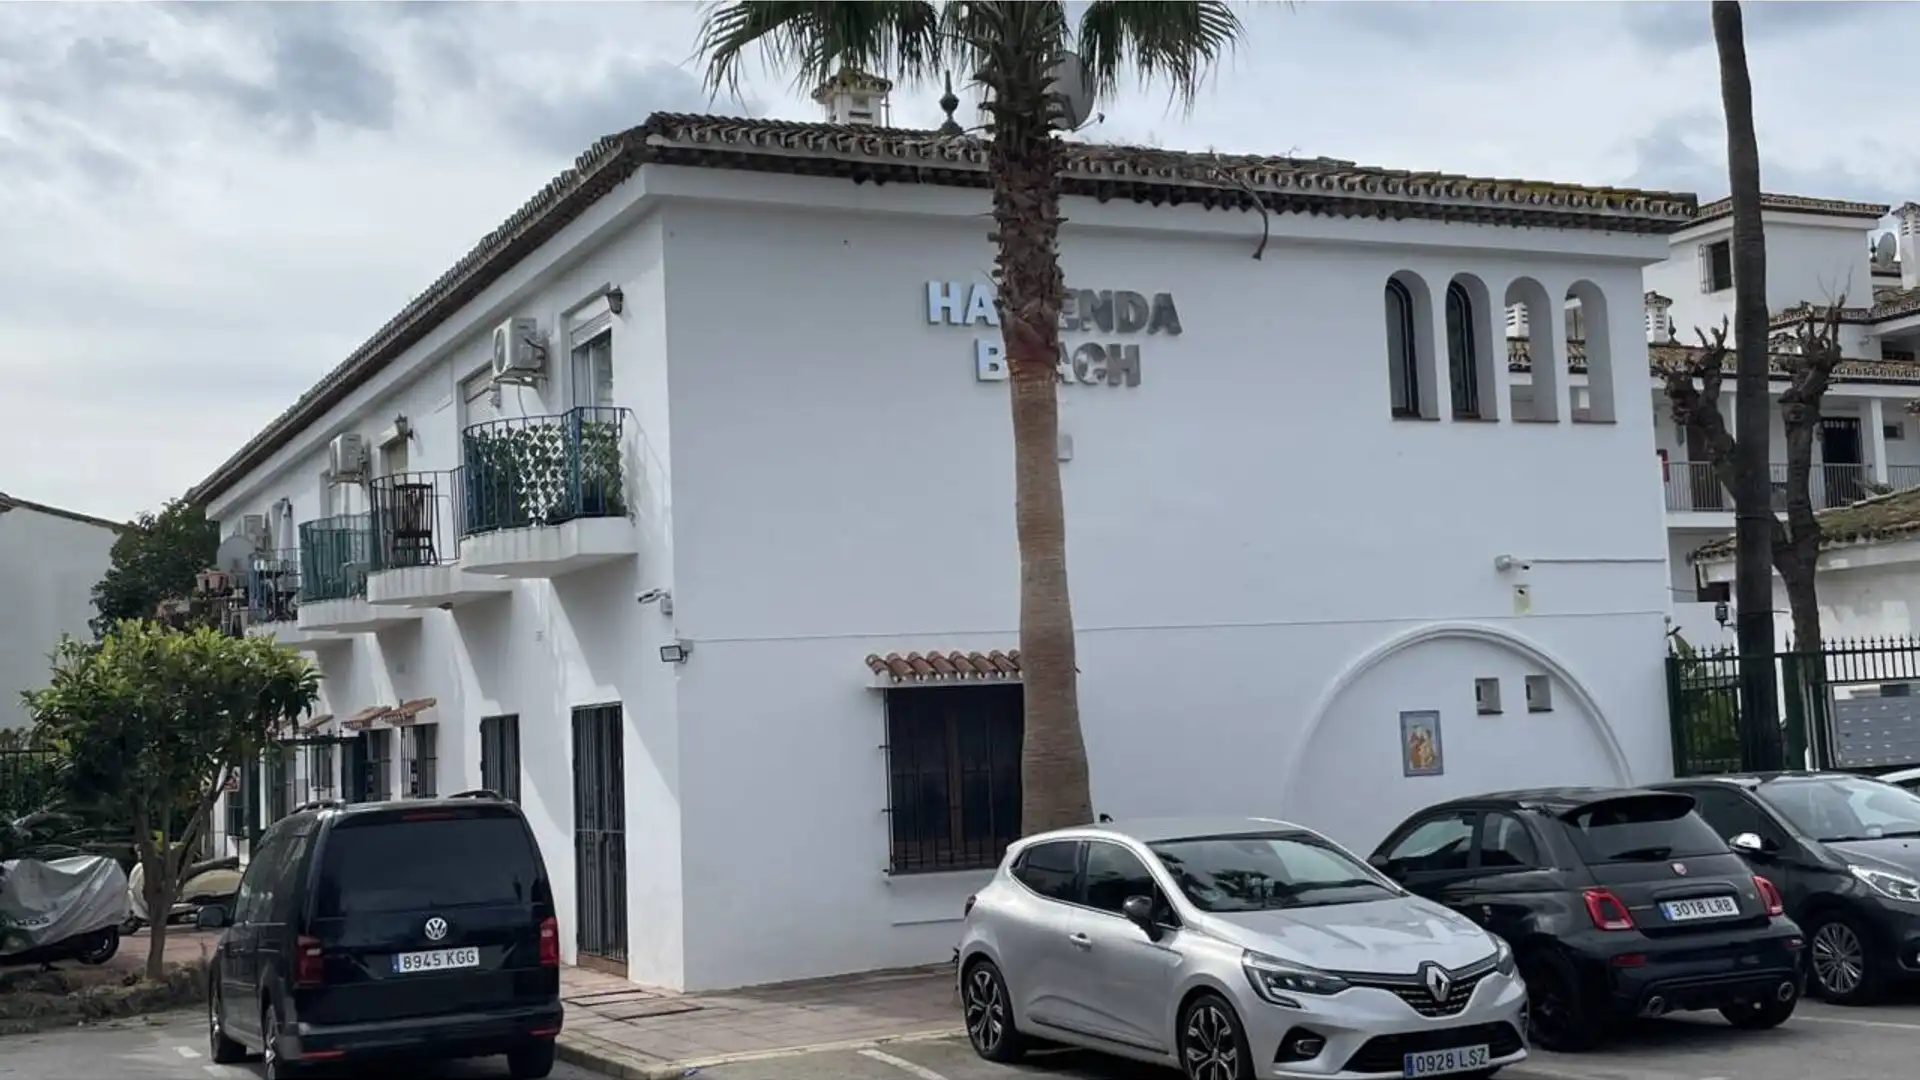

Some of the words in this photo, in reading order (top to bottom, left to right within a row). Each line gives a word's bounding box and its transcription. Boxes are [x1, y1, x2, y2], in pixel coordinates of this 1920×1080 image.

[926, 280, 1183, 335] HAENDA
[974, 337, 1142, 387] BACH
[1671, 901, 1707, 917] 3018
[1707, 898, 1733, 913] LRB
[403, 953, 441, 970] 8945
[446, 950, 475, 965] KGG
[1416, 1052, 1454, 1073] 0928
[1459, 1048, 1487, 1068] LSZ
